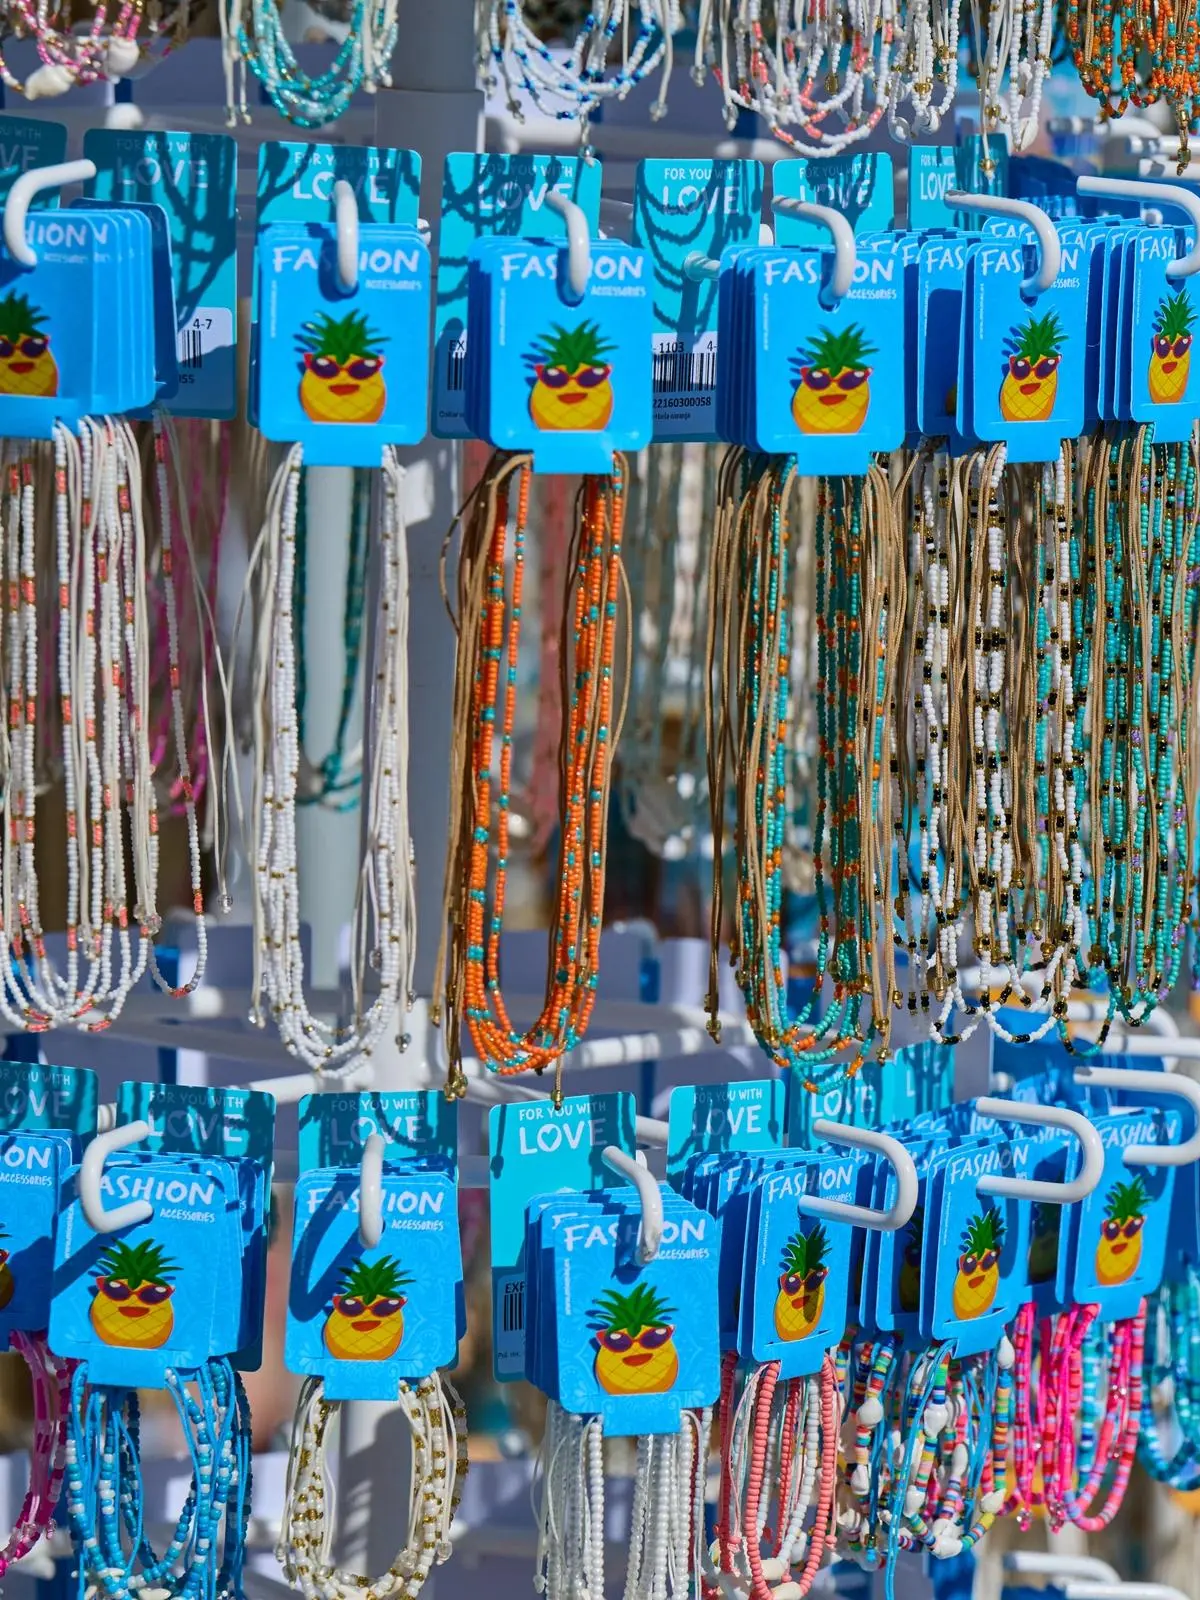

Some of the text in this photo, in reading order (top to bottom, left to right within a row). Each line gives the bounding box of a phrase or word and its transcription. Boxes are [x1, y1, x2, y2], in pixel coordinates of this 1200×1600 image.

[117, 156, 208, 188] LOVE
[664, 167, 740, 181] FOR YOU WITH
[662, 185, 741, 215] LOVE
[272, 245, 419, 274] FASION
[763, 258, 894, 286] FASON
[40, 1072, 71, 1086] WITH
[331, 1097, 425, 1112] FOR YOU WITH
[738, 1087, 763, 1101] WITH
[147, 1107, 244, 1142] LOVE
[519, 1107, 544, 1121] FOR
[575, 1100, 607, 1115] WITH
[692, 1104, 762, 1137] LOVE
[330, 1115, 427, 1147] LOVE
[519, 1117, 608, 1155] LOVE
[950, 1144, 1029, 1185] FASHION
[97, 1174, 215, 1206] ASHION
[768, 1164, 853, 1205] FASHION
[307, 1186, 445, 1215] FASION
[159, 1207, 216, 1224] ACCESSORIES
[391, 1218, 444, 1231] ACCESSORIES
